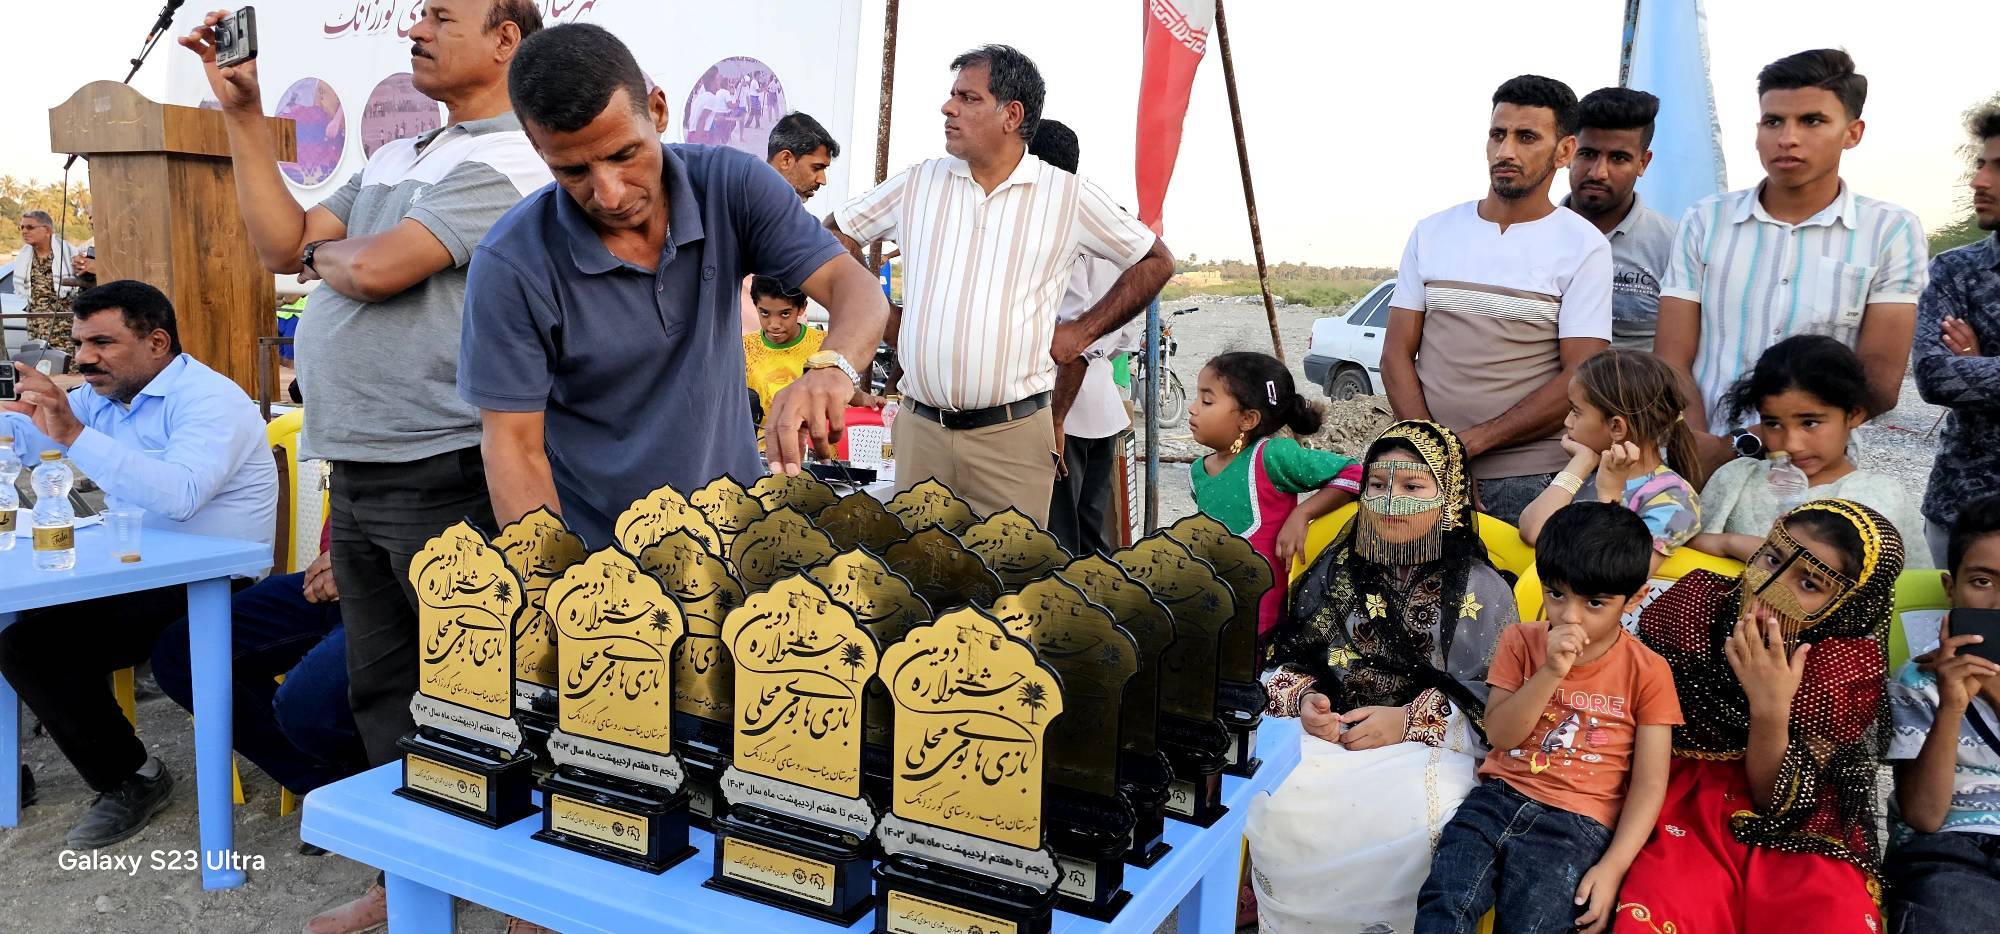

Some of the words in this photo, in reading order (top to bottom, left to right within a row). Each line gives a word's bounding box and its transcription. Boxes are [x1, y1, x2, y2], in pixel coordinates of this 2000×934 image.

[1612, 270, 1652, 286] AGIC
[1551, 688, 1625, 719] LORE
[429, 707, 441, 717] سال
[441, 711, 450, 720] ماه
[451, 715, 479, 730] اردیبهشت
[480, 723, 495, 733] هفتم
[495, 726, 501, 735] تا
[502, 732, 517, 742] پنجم
[570, 745, 584, 755] سال
[585, 748, 596, 757] ماه
[596, 753, 631, 768] اردیبهشت
[632, 760, 651, 770] هفتم
[651, 763, 658, 772] تا
[659, 767, 678, 780] پنجم
[746, 784, 762, 795] سال
[763, 789, 776, 799] ماه
[776, 794, 815, 811] اردیبهشت
[816, 804, 837, 815] هفتم
[839, 807, 846, 817] تا
[847, 813, 868, 826] پنجم
[906, 832, 925, 845] سال
[926, 836, 941, 848] ماه
[941, 843, 987, 862] اردیبهشت
[988, 854, 1014, 867] هفتم
[1015, 858, 1023, 869] تا
[1024, 863, 1050, 879] پنجم
